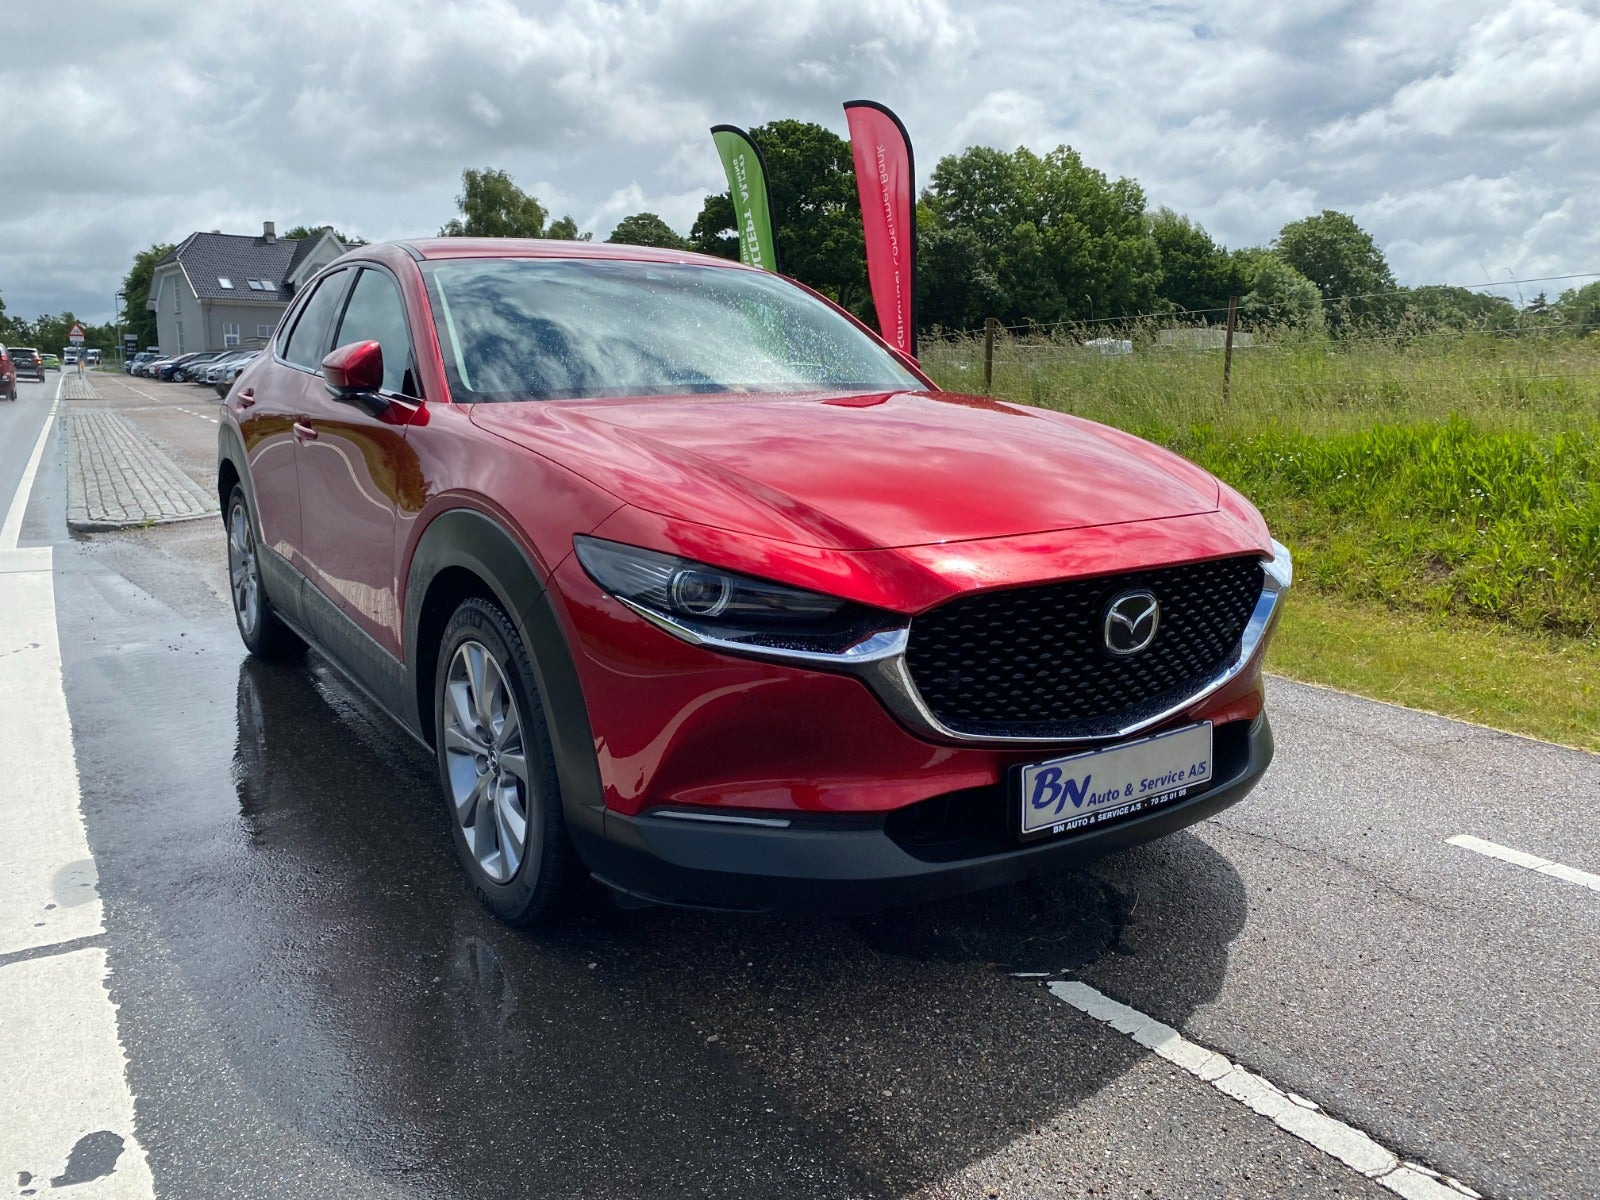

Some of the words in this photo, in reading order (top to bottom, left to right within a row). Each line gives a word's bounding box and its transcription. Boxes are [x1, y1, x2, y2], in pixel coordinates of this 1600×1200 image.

[1032, 767, 1092, 815] BN
[1087, 789, 1120, 807] Auto
[1124, 782, 1134, 797] &
[1139, 770, 1185, 793] Service
[1188, 760, 1207, 778] A/S
[1053, 825, 1065, 834] BN
[1066, 818, 1088, 831] AUTO
[1097, 806, 1129, 821] SERVICE
[1130, 803, 1142, 813] A/S
[1150, 797, 1160, 806] 70
[1169, 791, 1178, 800] 01
